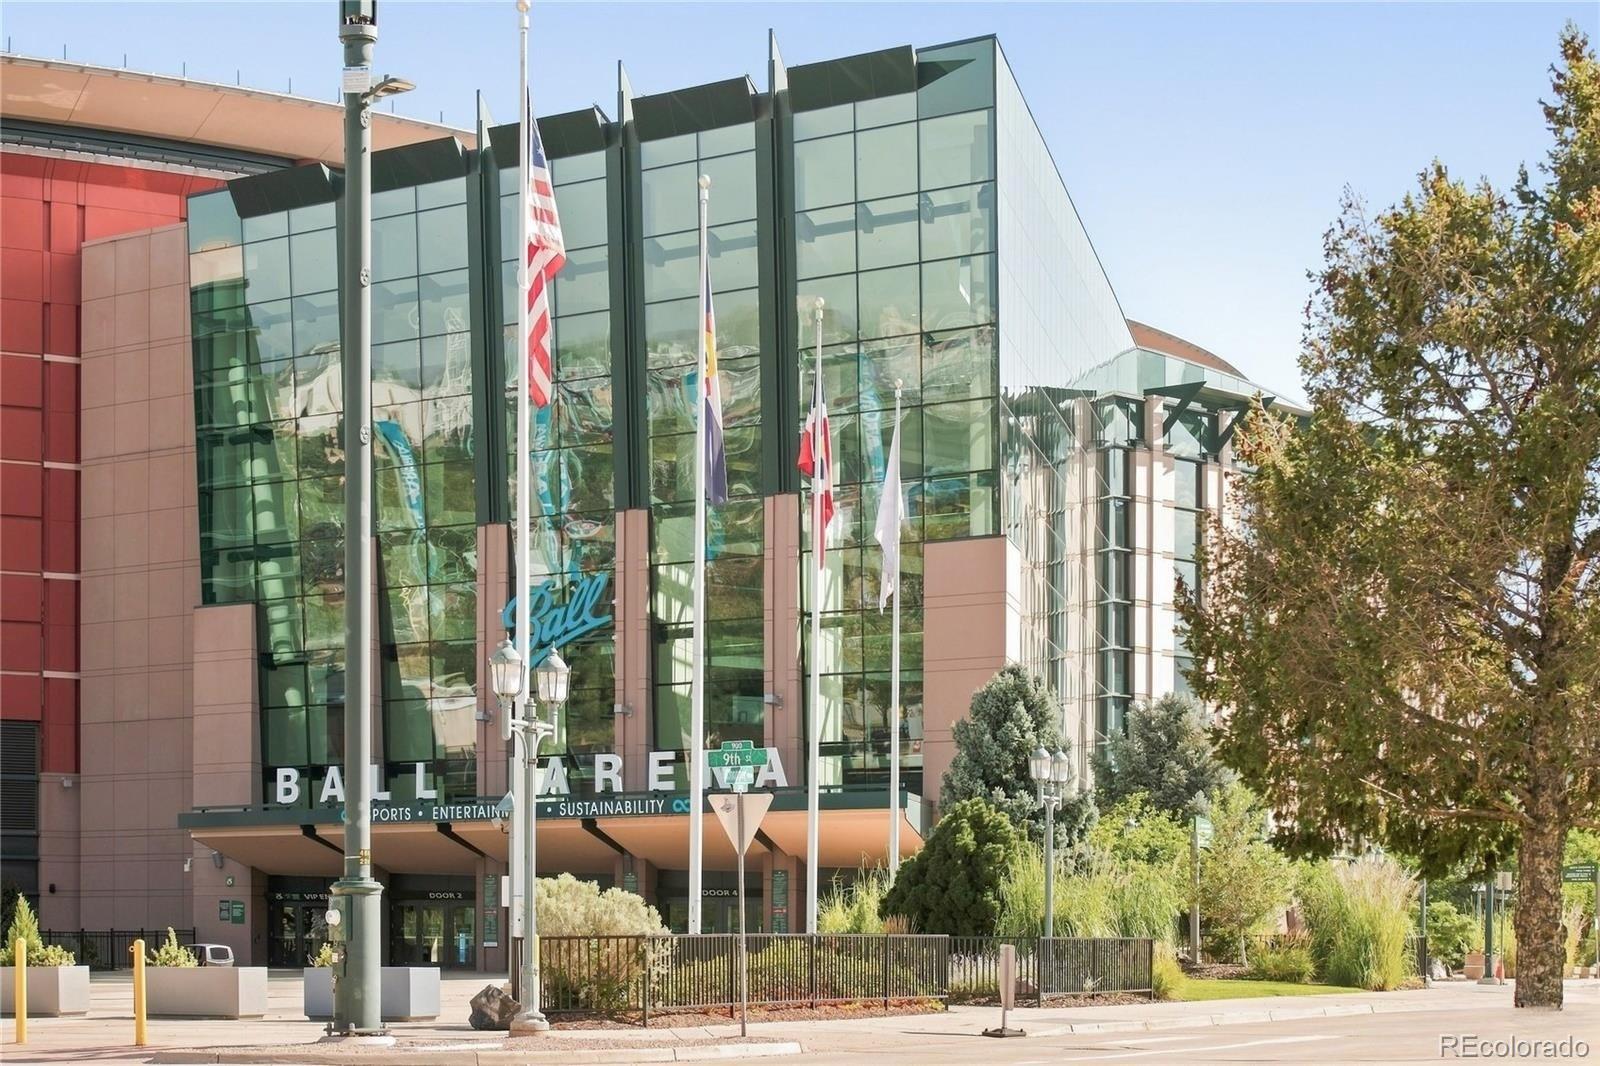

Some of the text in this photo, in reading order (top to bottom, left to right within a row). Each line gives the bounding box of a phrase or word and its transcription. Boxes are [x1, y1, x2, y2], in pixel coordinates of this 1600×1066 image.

[502, 572, 612, 672] Ball
[722, 752, 742, 766] 9th
[276, 761, 438, 804] BALL
[371, 806, 411, 822] PORTS
[559, 799, 665, 817] SUSTAINABILITY
[701, 889, 730, 897] DOOR
